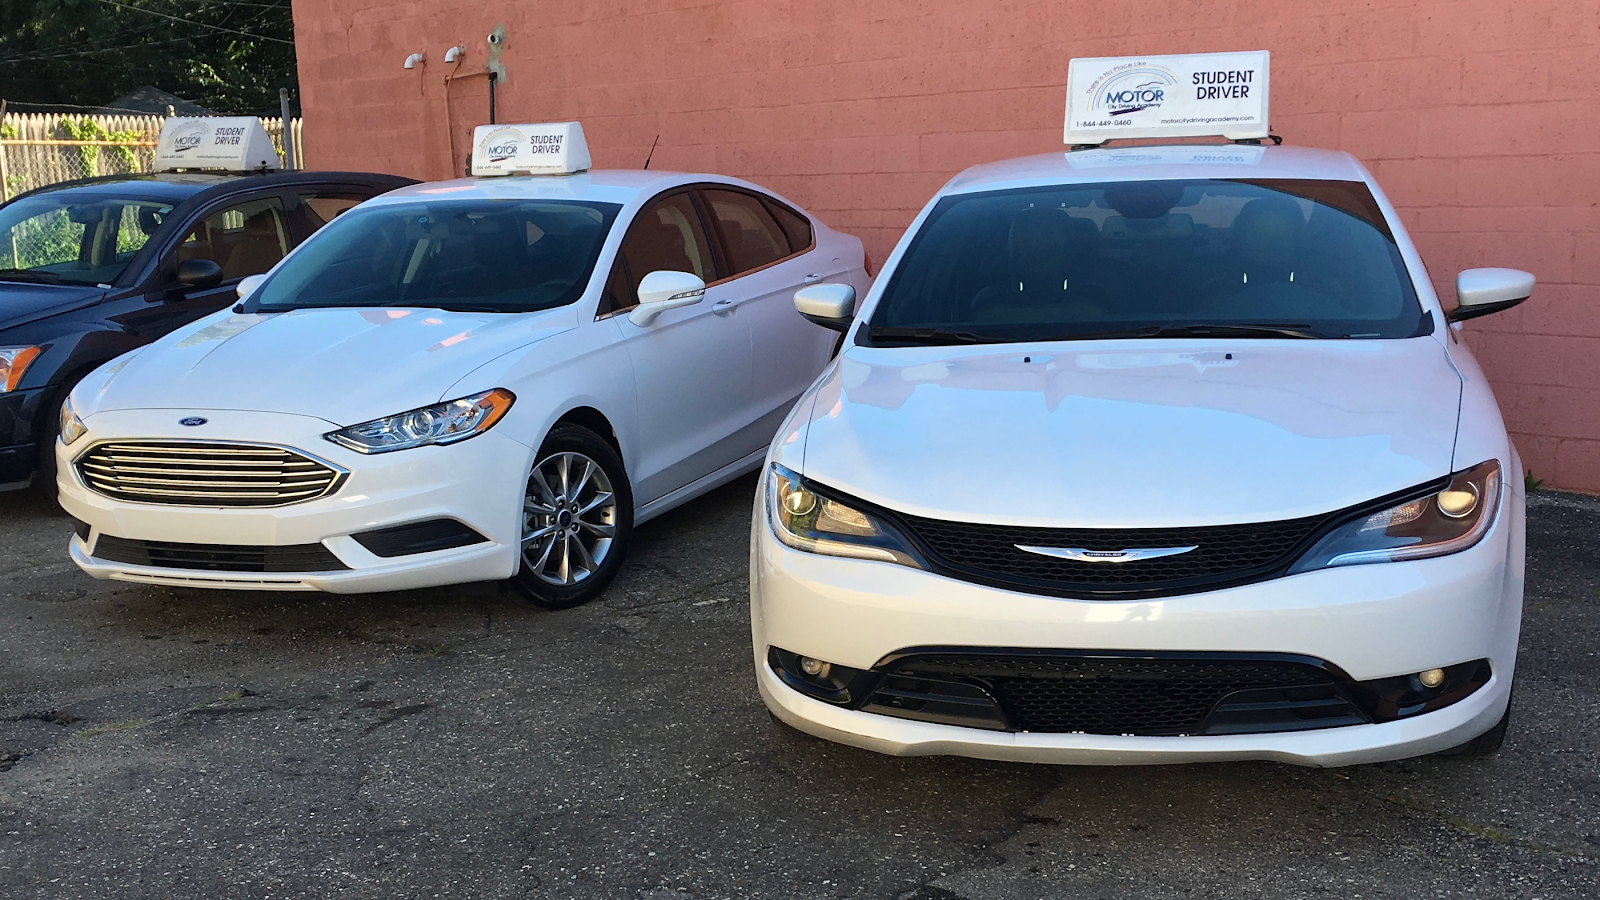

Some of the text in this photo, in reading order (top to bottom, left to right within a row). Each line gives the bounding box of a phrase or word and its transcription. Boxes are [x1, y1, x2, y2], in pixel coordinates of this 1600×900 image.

[1113, 63, 1133, 72] Place
[1192, 70, 1254, 85] STUDENT
[1106, 89, 1164, 104] MOTOR
[1196, 85, 1250, 100] DRIVER
[1076, 119, 1132, 127] 1-844-449-0460
[1160, 115, 1254, 124] motorcitydrivingacademy.com
[215, 127, 246, 136] STUDENT
[174, 136, 202, 145] MOTOR
[214, 136, 241, 145] DRIVER
[530, 134, 563, 144] STUDENT
[488, 145, 518, 155] MOTOR
[532, 144, 561, 154] DRIVER
